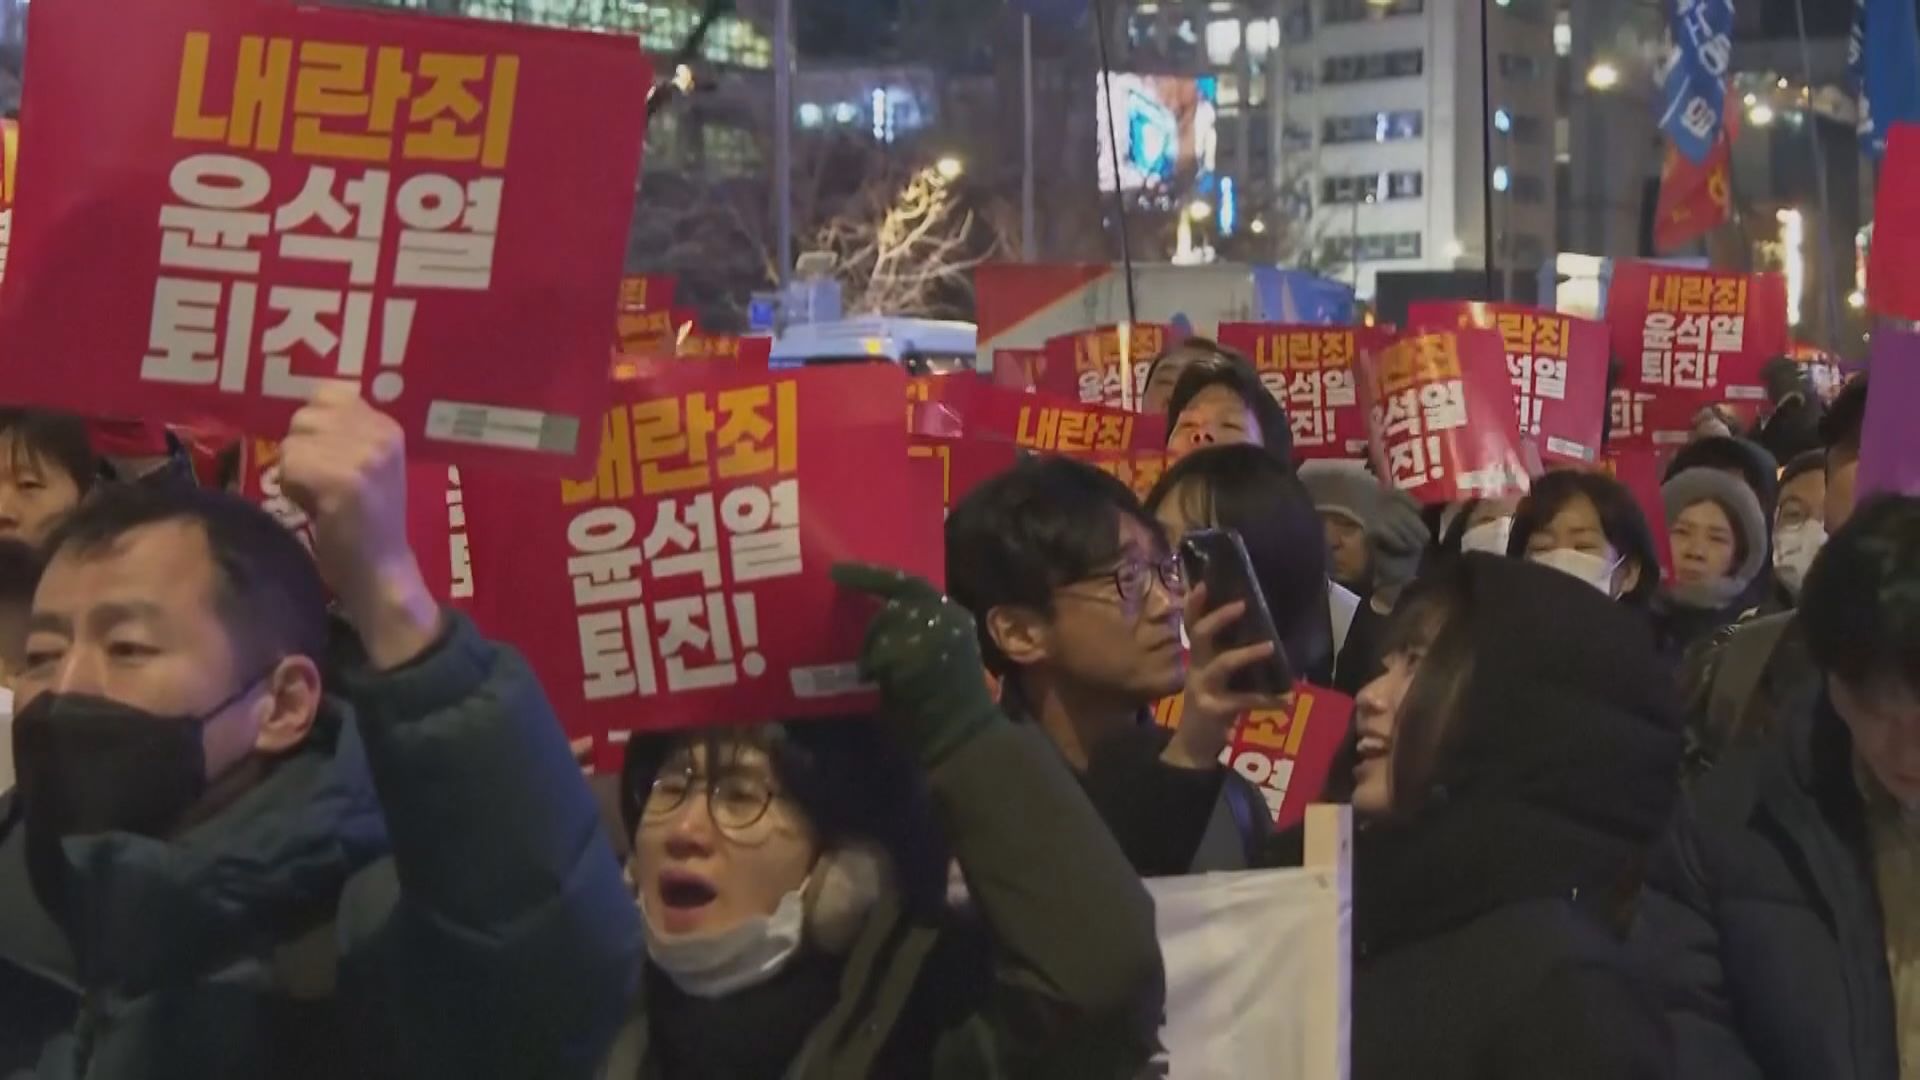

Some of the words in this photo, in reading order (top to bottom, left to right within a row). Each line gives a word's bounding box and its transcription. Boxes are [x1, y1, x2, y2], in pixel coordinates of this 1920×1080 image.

[172, 30, 521, 169] 내란죄
[159, 153, 504, 290] 윤석열
[1648, 274, 1748, 315] 내란죄
[140, 275, 417, 402] 퇴진!
[1256, 332, 1354, 369] 내란죄
[1643, 312, 1744, 352] 윤석열
[1506, 353, 1567, 400] 석열
[1641, 351, 1719, 389] 퇴진!
[1016, 404, 1134, 451] 내란죄
[1289, 409, 1337, 447] 진!
[1388, 435, 1445, 490] 진!
[567, 478, 803, 606] 윤석열
[577, 591, 767, 700] 퇴진!
